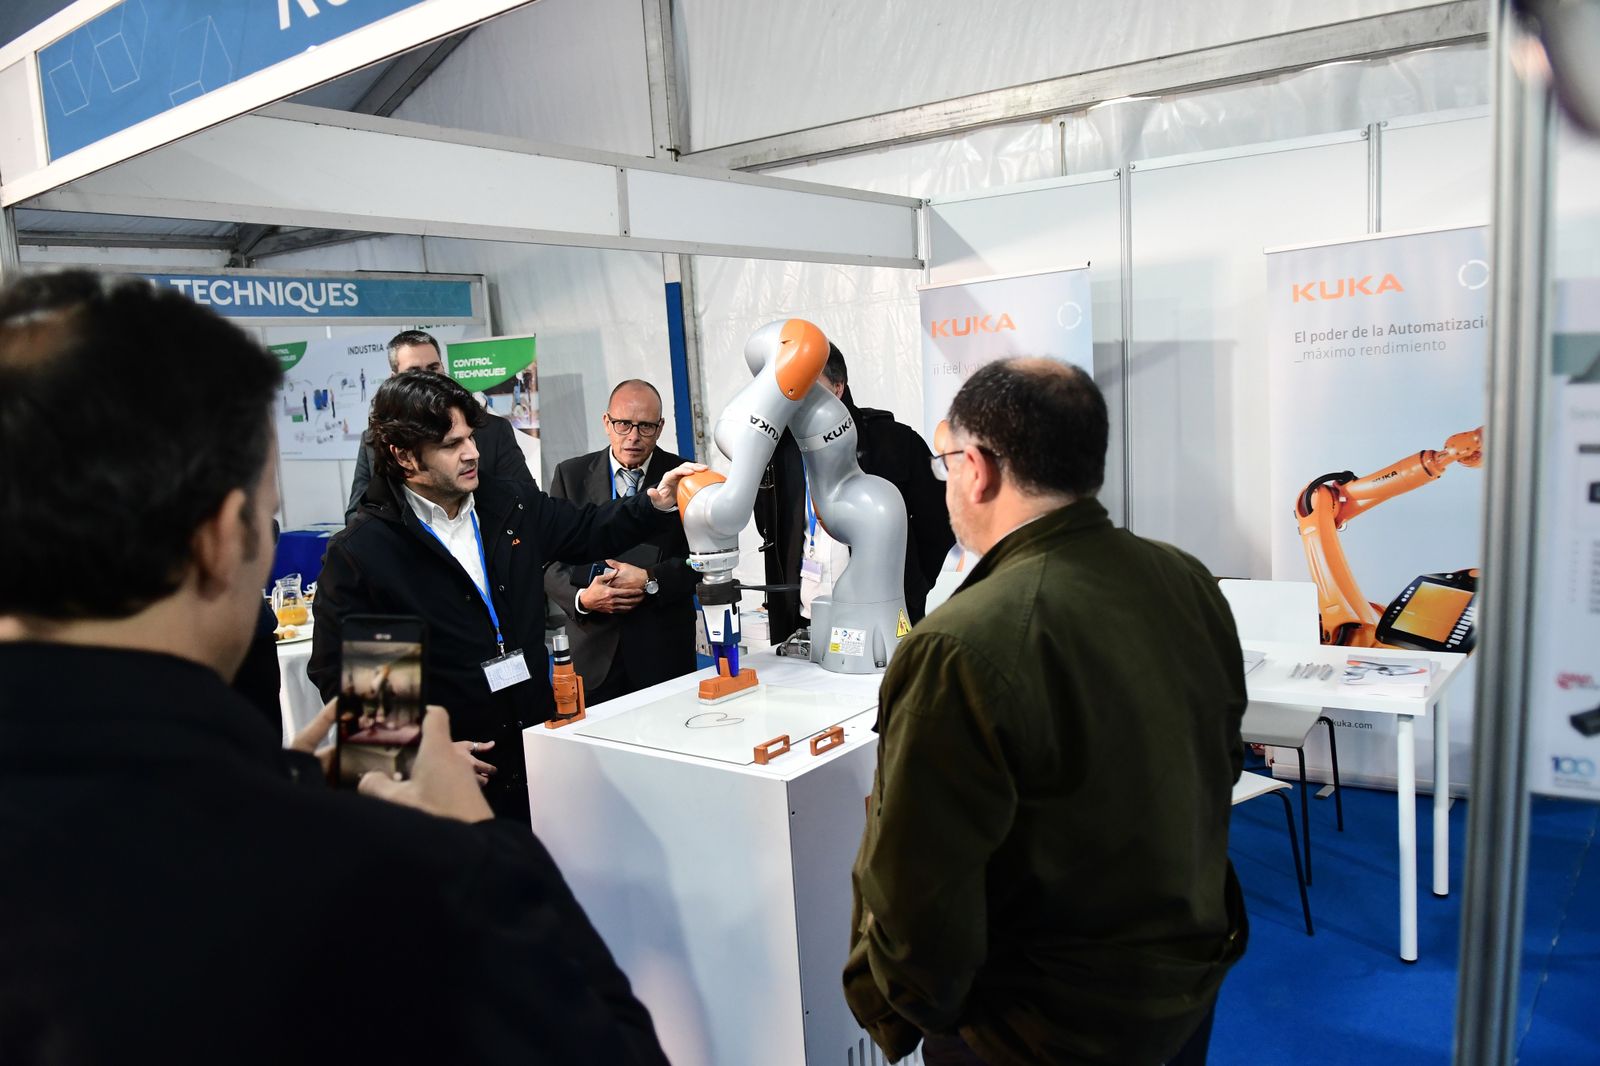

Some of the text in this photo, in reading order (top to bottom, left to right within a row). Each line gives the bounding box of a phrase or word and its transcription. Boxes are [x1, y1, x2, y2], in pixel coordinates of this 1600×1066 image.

[170, 279, 358, 313] TECHNIQUES
[1292, 273, 1405, 303] KUKA
[931, 312, 1016, 338] KUKA
[1295, 331, 1306, 343] El
[1310, 327, 1348, 344] poder
[1352, 326, 1368, 339] de
[1372, 325, 1384, 337] la
[347, 343, 385, 356] INDUSTRIA
[1360, 340, 1446, 356] rendimiento
[453, 357, 493, 368] CONTROL
[454, 367, 506, 379] TECHNIQUES
[823, 417, 853, 443] KUKA
